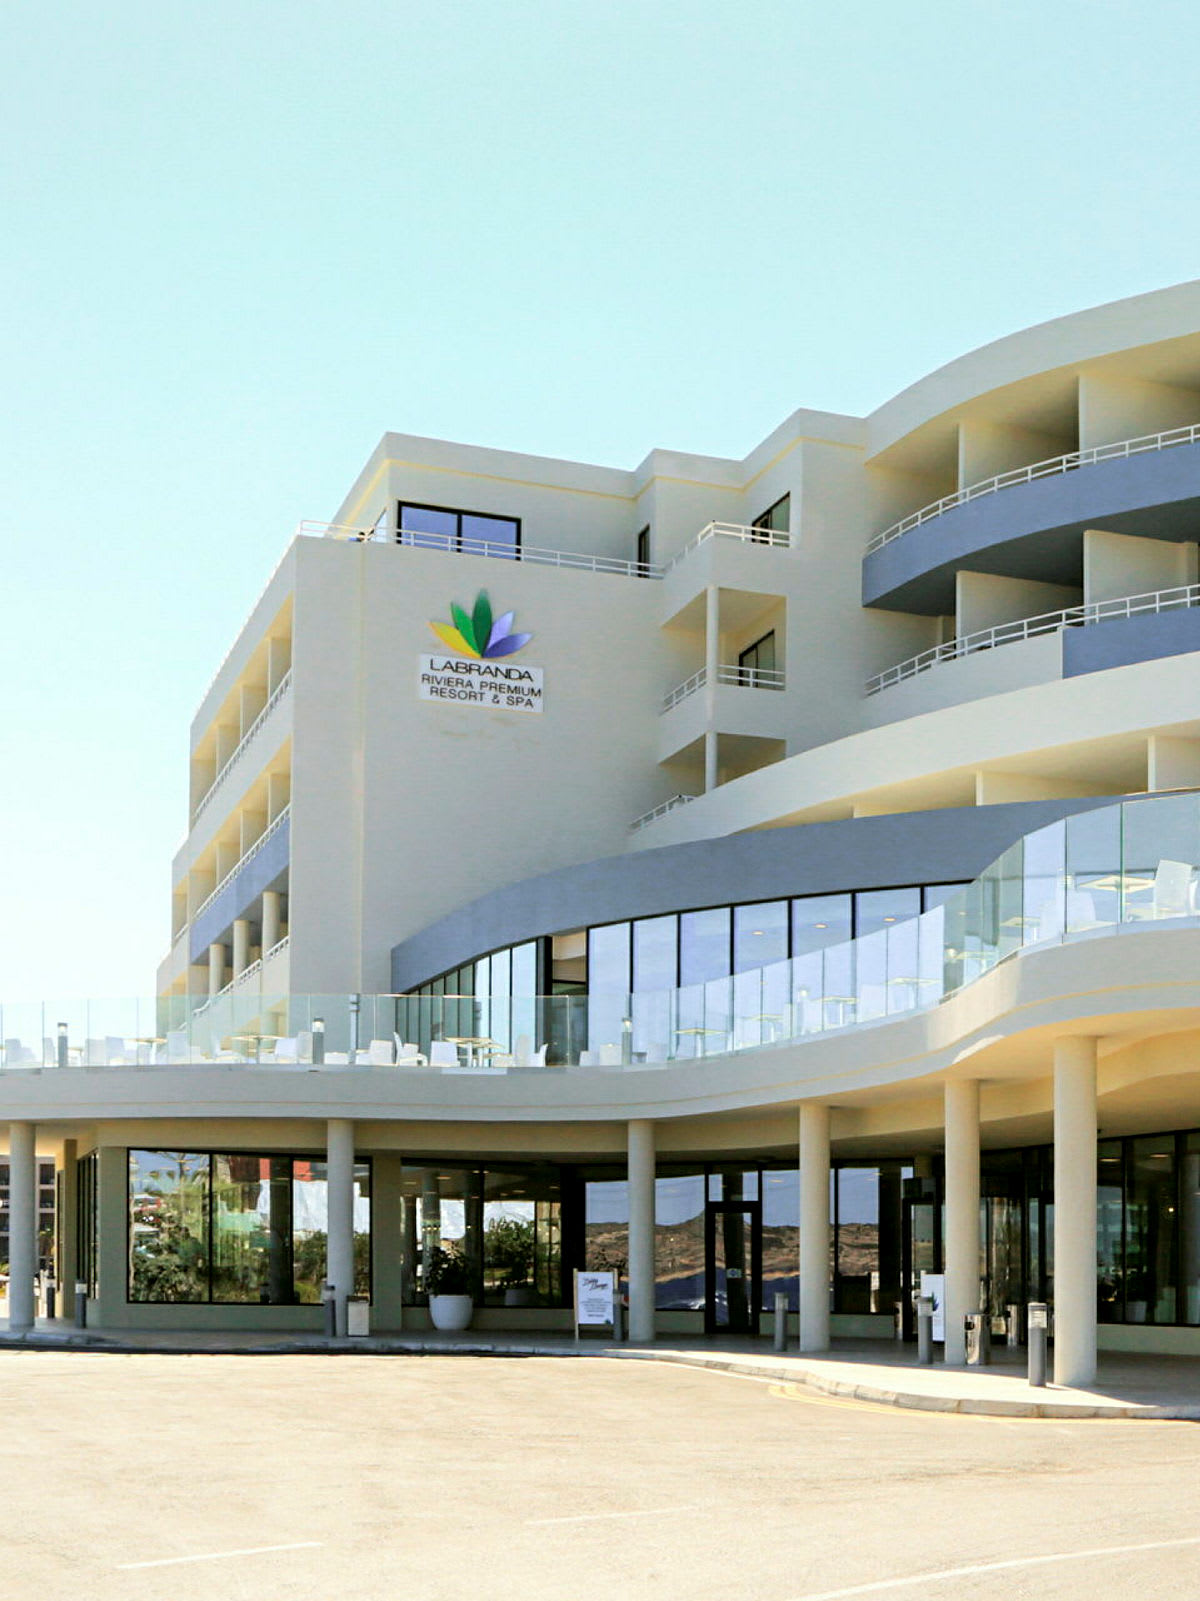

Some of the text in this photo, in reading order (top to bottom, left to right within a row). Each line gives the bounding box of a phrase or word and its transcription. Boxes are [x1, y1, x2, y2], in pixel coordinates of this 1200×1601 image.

[430, 659, 534, 682] LABRANDA
[421, 674, 541, 697] RIVIERA PREMIUM
[430, 687, 534, 708] RESORT & SPA
